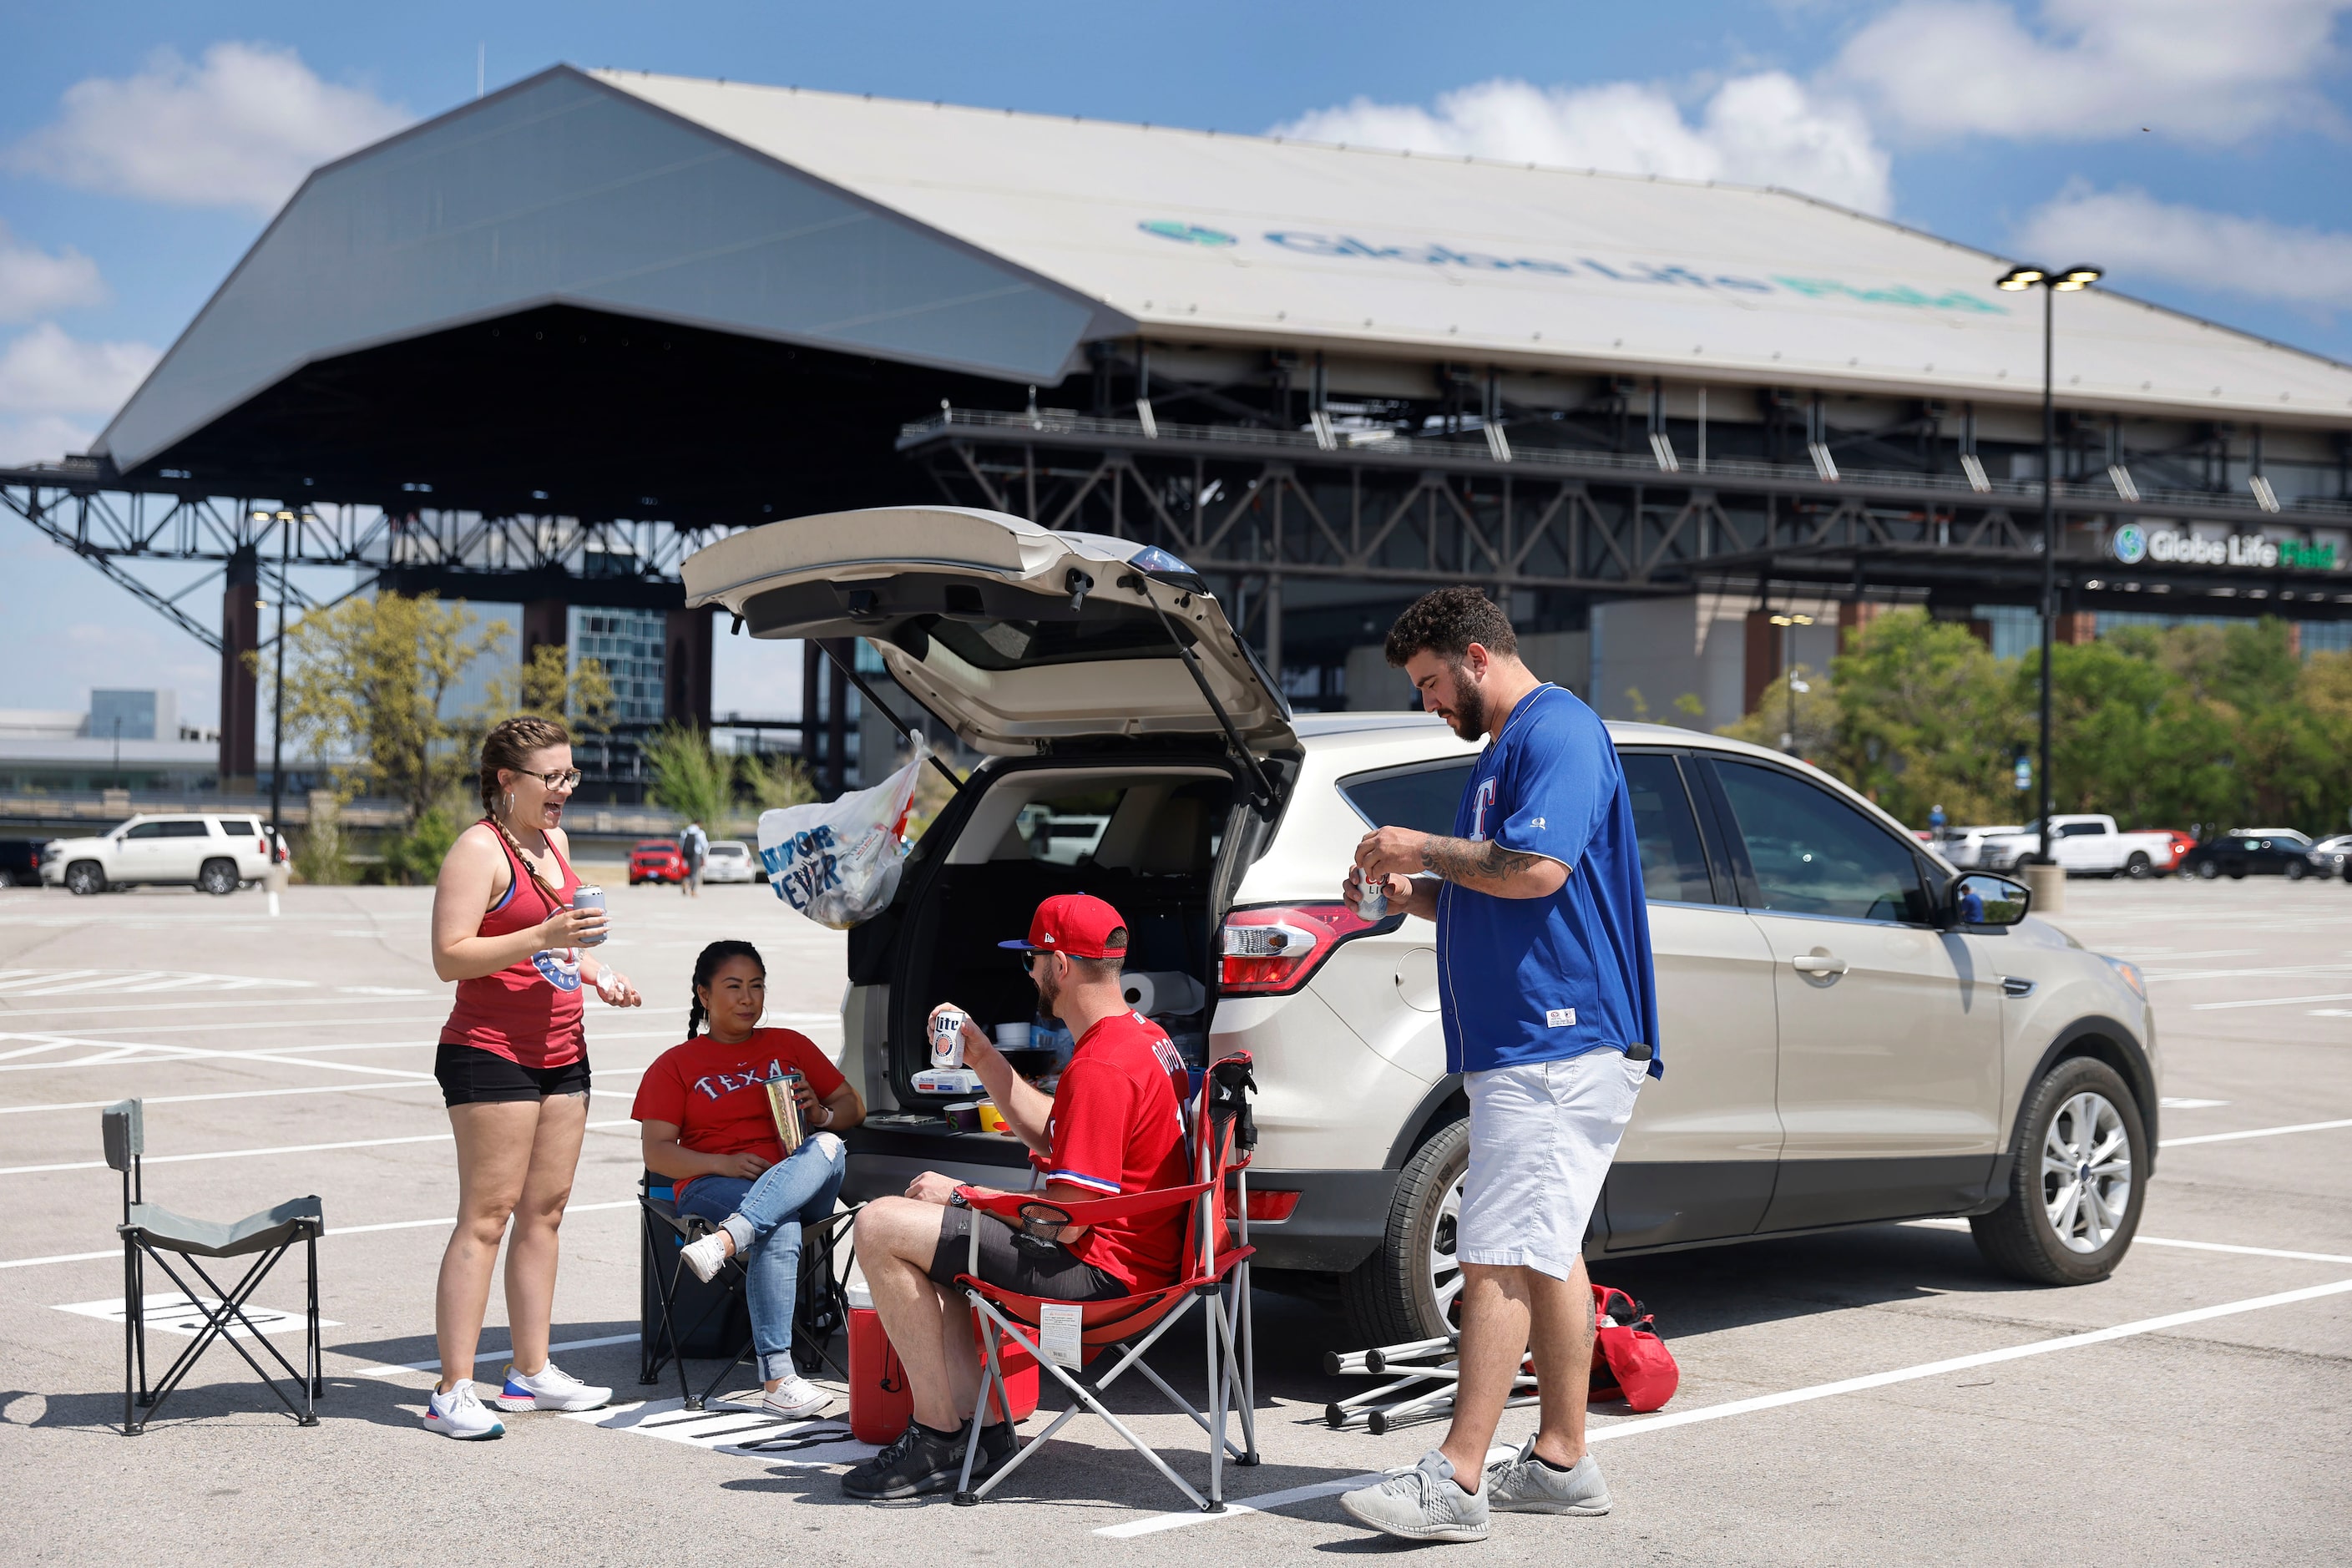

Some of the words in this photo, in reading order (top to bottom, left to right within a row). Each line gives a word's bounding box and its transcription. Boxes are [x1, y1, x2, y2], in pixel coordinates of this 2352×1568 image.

[1262, 230, 1573, 276] Globe
[1576, 256, 1775, 295] Life
[2148, 530, 2227, 564] Globe
[2228, 534, 2278, 567] Life
[2279, 539, 2336, 570] Field
[935, 1016, 959, 1033] Lite
[694, 1059, 797, 1102] TEXA
